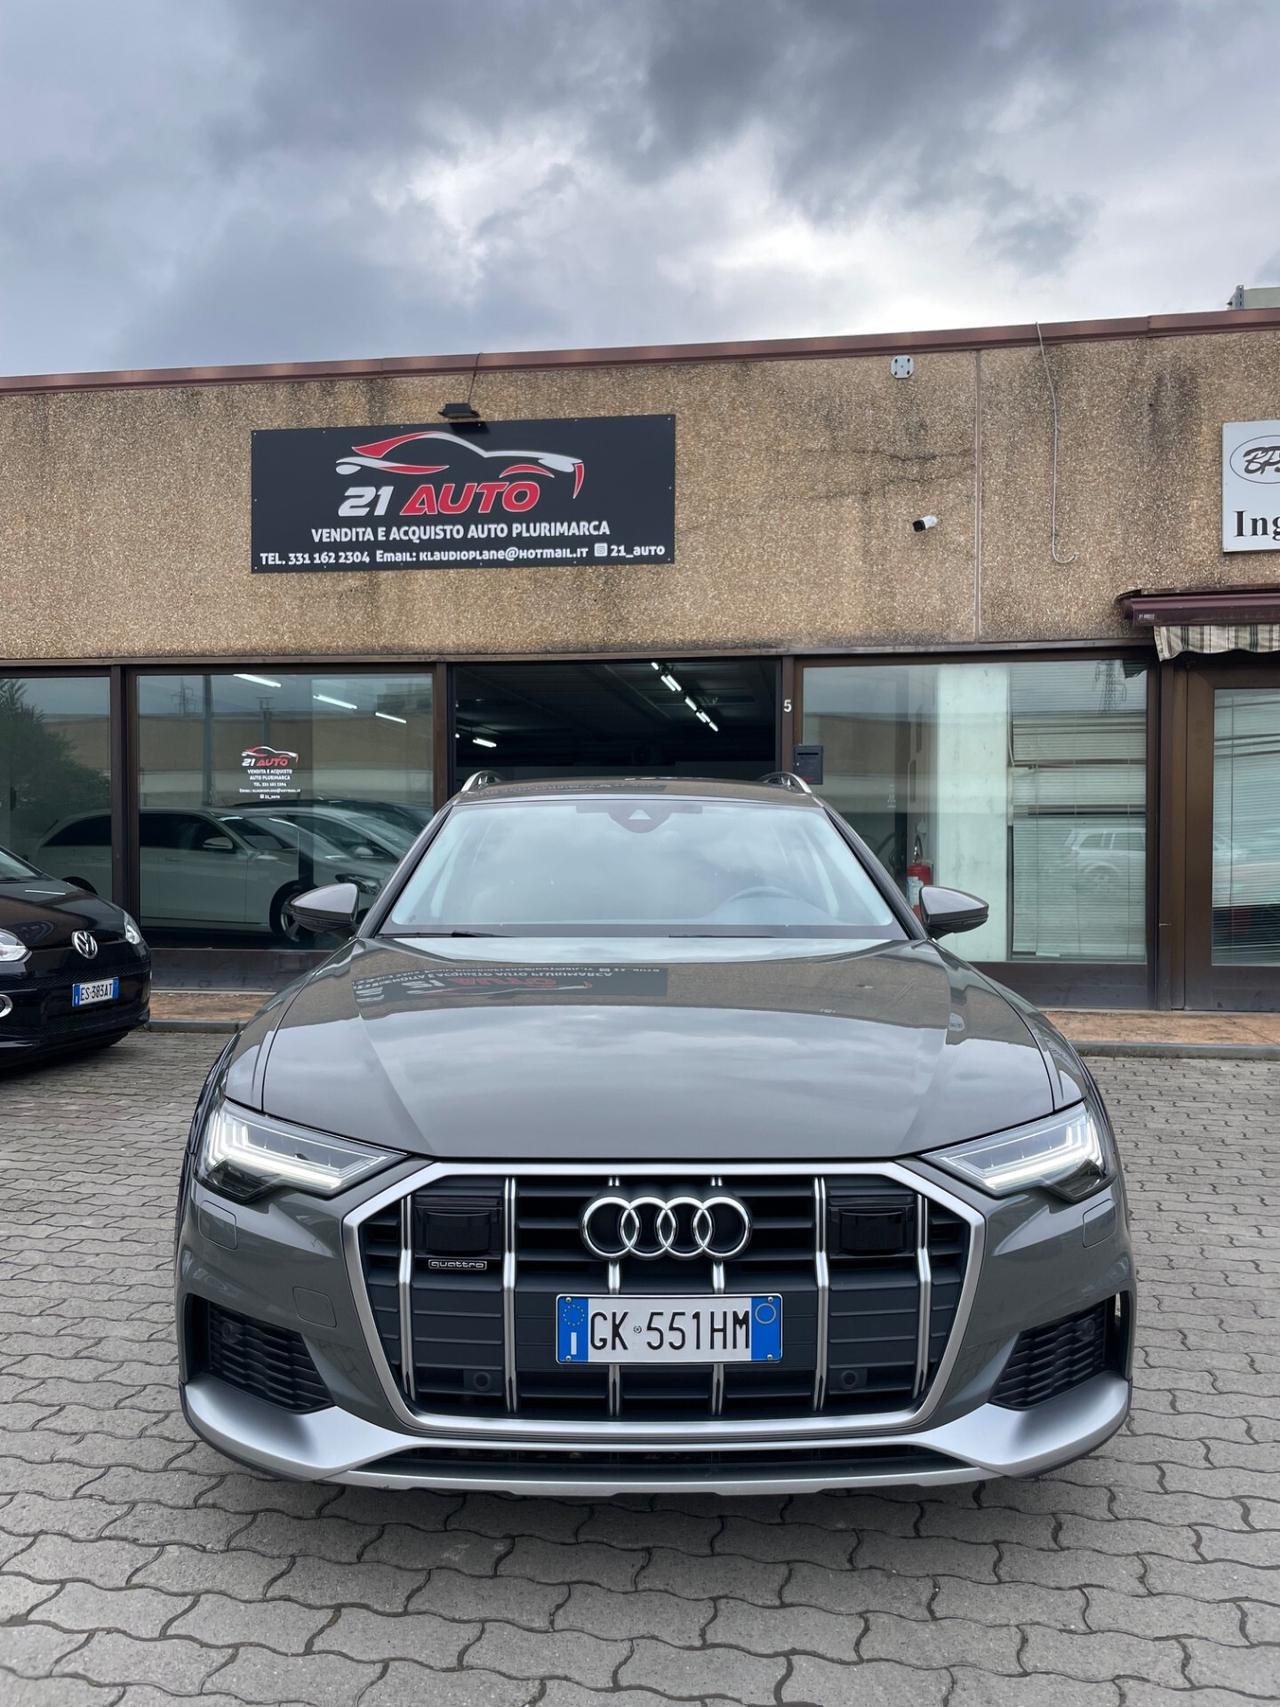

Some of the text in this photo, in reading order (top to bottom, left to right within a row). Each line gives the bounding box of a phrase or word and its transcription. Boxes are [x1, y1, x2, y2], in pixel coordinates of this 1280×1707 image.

[338, 481, 541, 517] 21 AUTO
[311, 520, 611, 543] VENDITA E ACQUISTO AUTO PLURIMARCA
[260, 552, 286, 566] TEL.
[288, 552, 311, 564] 331
[313, 551, 336, 564] 162
[338, 551, 370, 564] 2304
[783, 699, 792, 713] 5
[241, 758, 289, 767] 21 AUTO
[80, 986, 90, 1002] ES
[430, 1261, 485, 1270] quattro
[589, 1310, 750, 1351] GK 551HM
